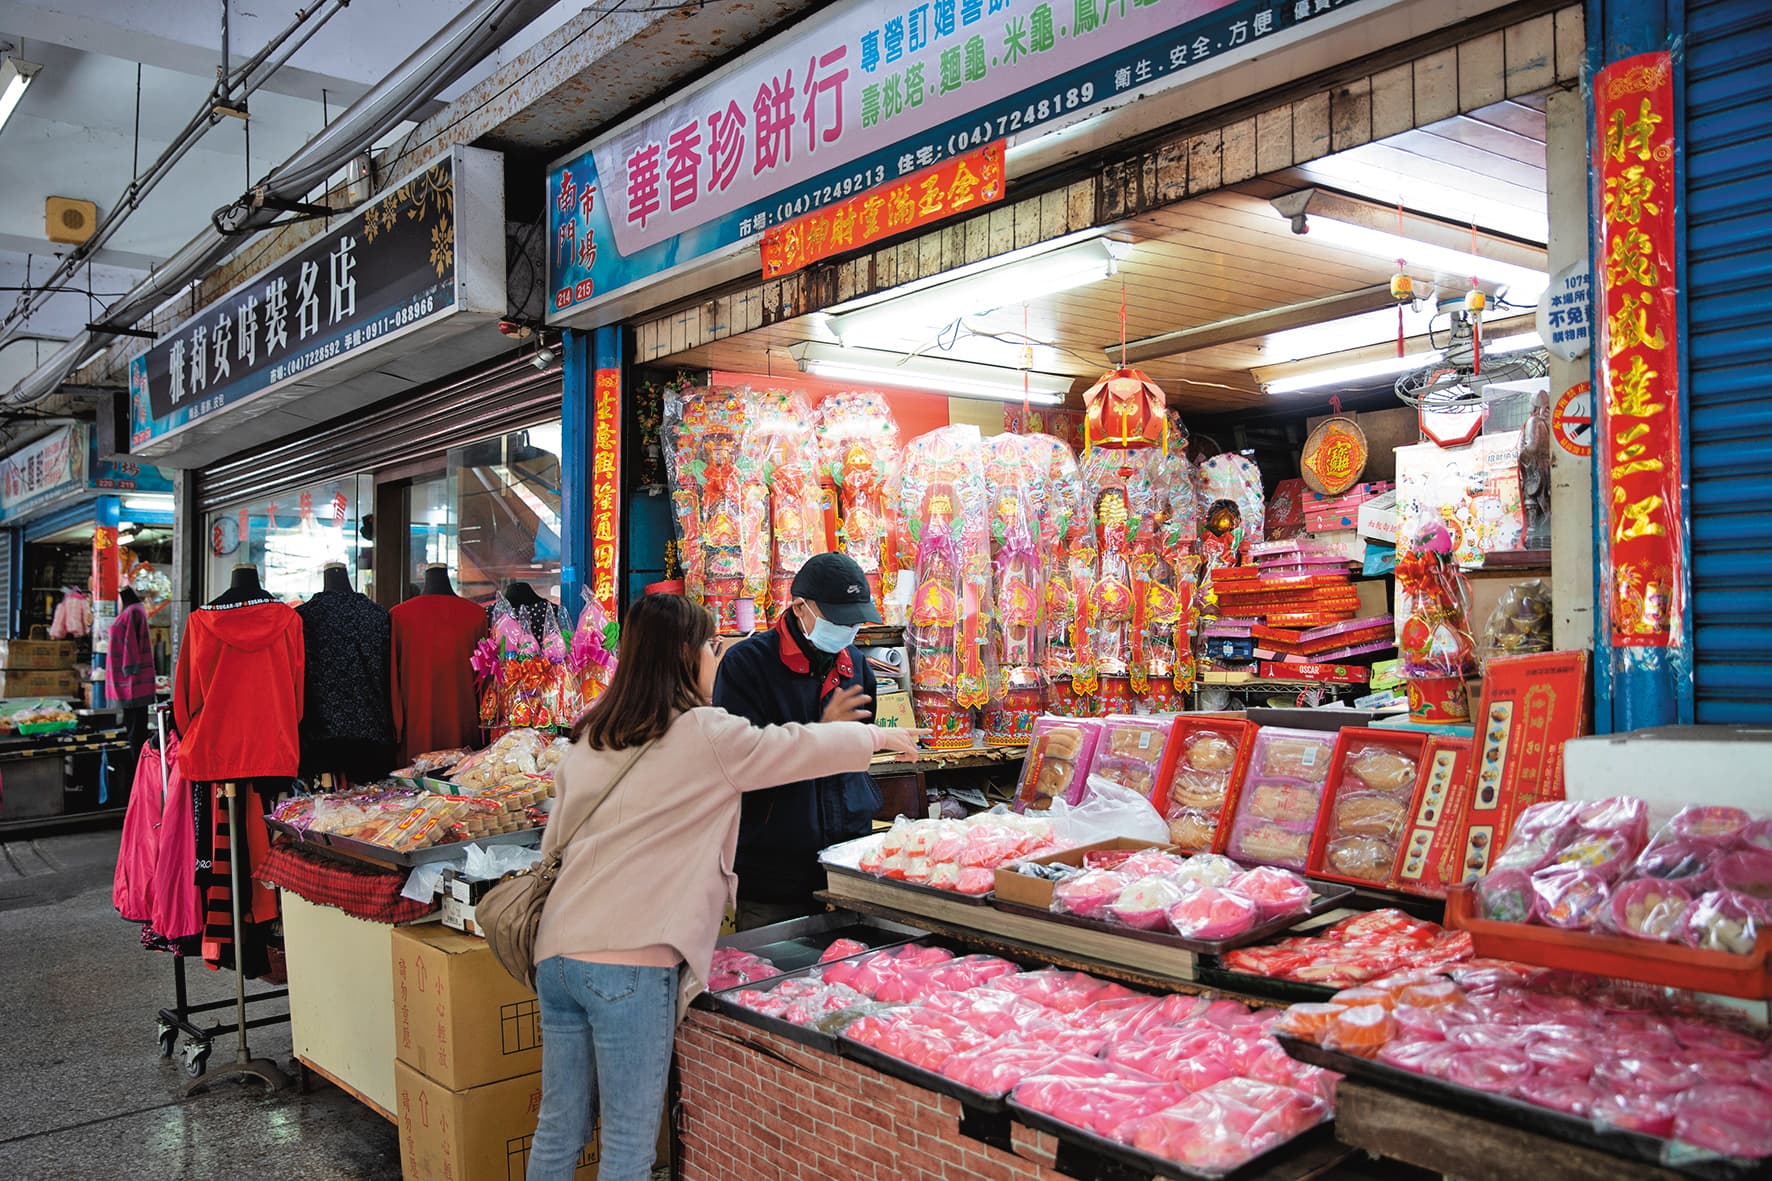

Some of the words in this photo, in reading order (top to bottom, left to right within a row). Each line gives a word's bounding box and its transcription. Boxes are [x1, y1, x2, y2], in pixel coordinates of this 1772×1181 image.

[627, 44, 850, 229] 華香珍餅行
[169, 236, 358, 405] 雅莉安時裝名店
[557, 290, 571, 306] 214
[577, 280, 592, 298] 215
[1299, 665, 1320, 675] OSCAR
